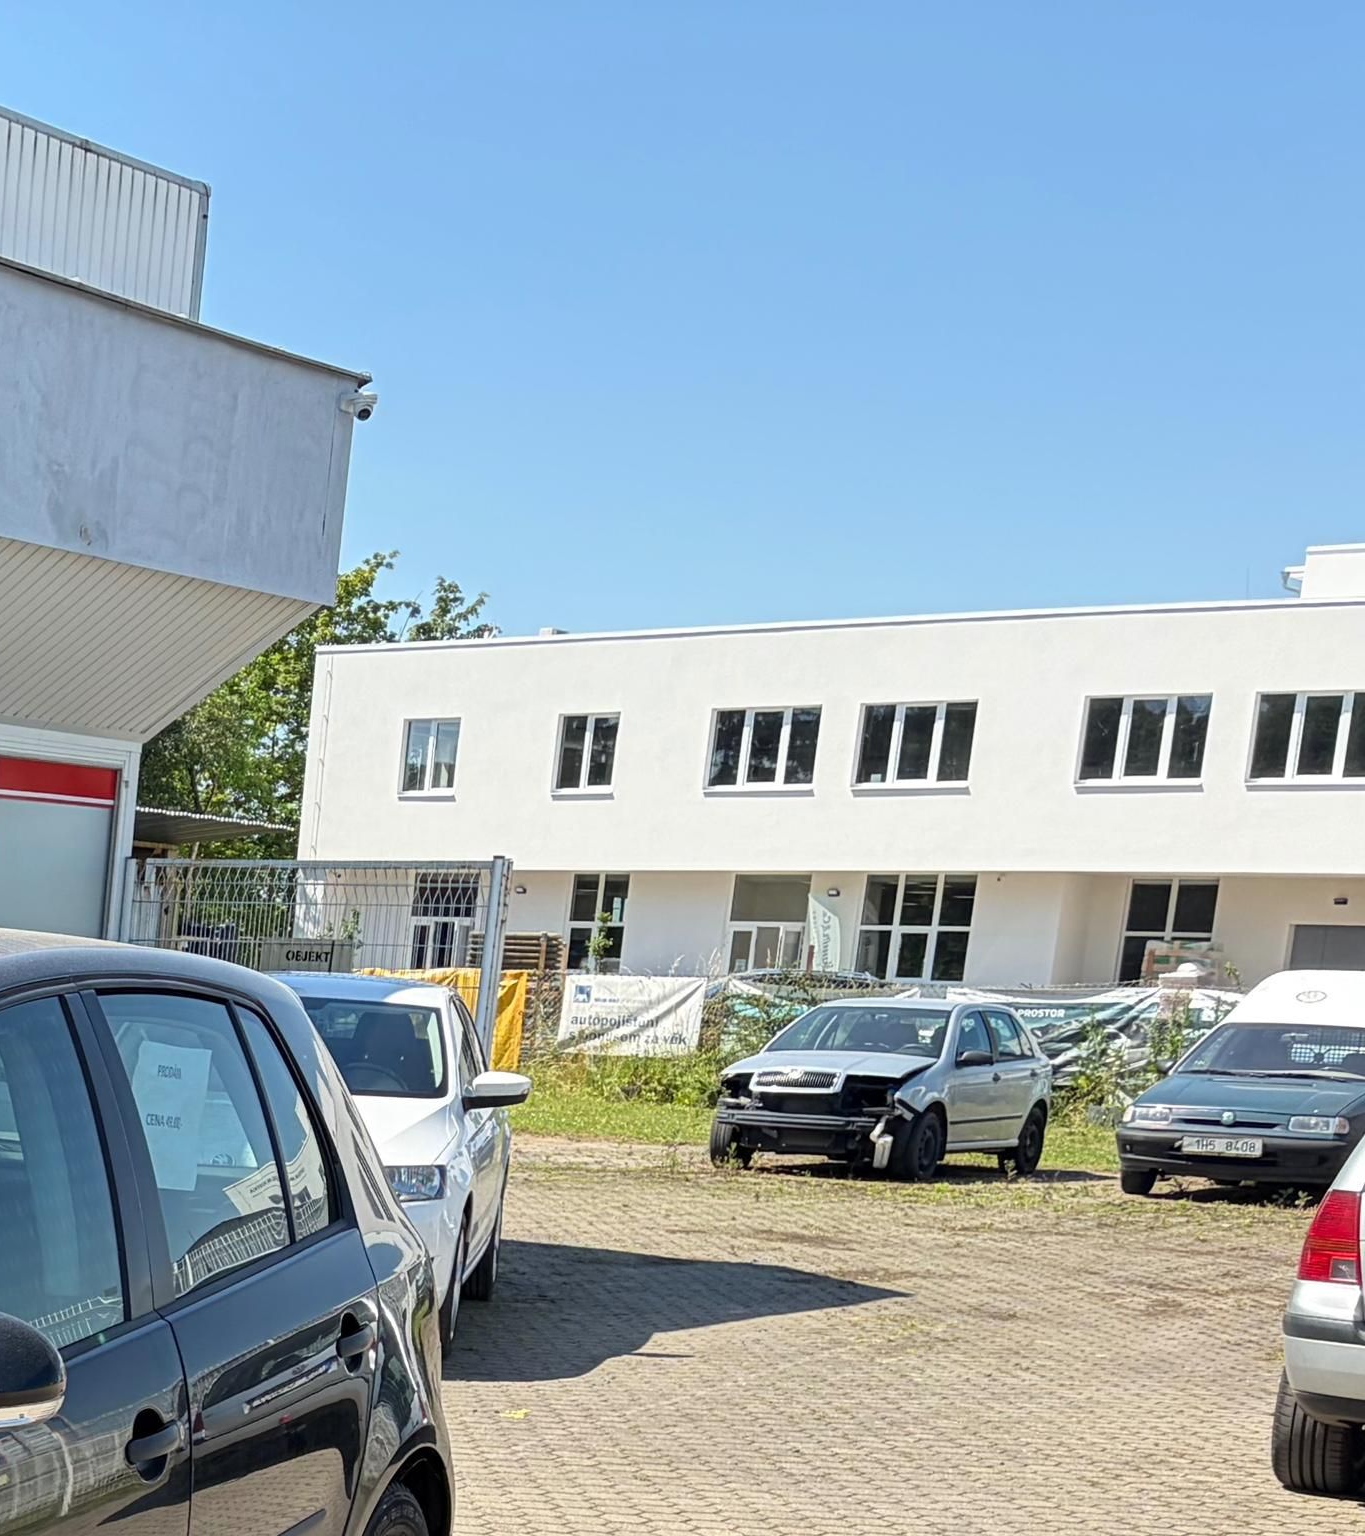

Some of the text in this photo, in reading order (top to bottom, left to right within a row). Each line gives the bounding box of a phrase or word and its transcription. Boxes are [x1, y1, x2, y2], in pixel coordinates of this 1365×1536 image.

[285, 950, 331, 963] OBJEKT
[1019, 1008, 1065, 1019] PROSTOR
[1195, 1139, 1256, 1152] 1H5 8408
